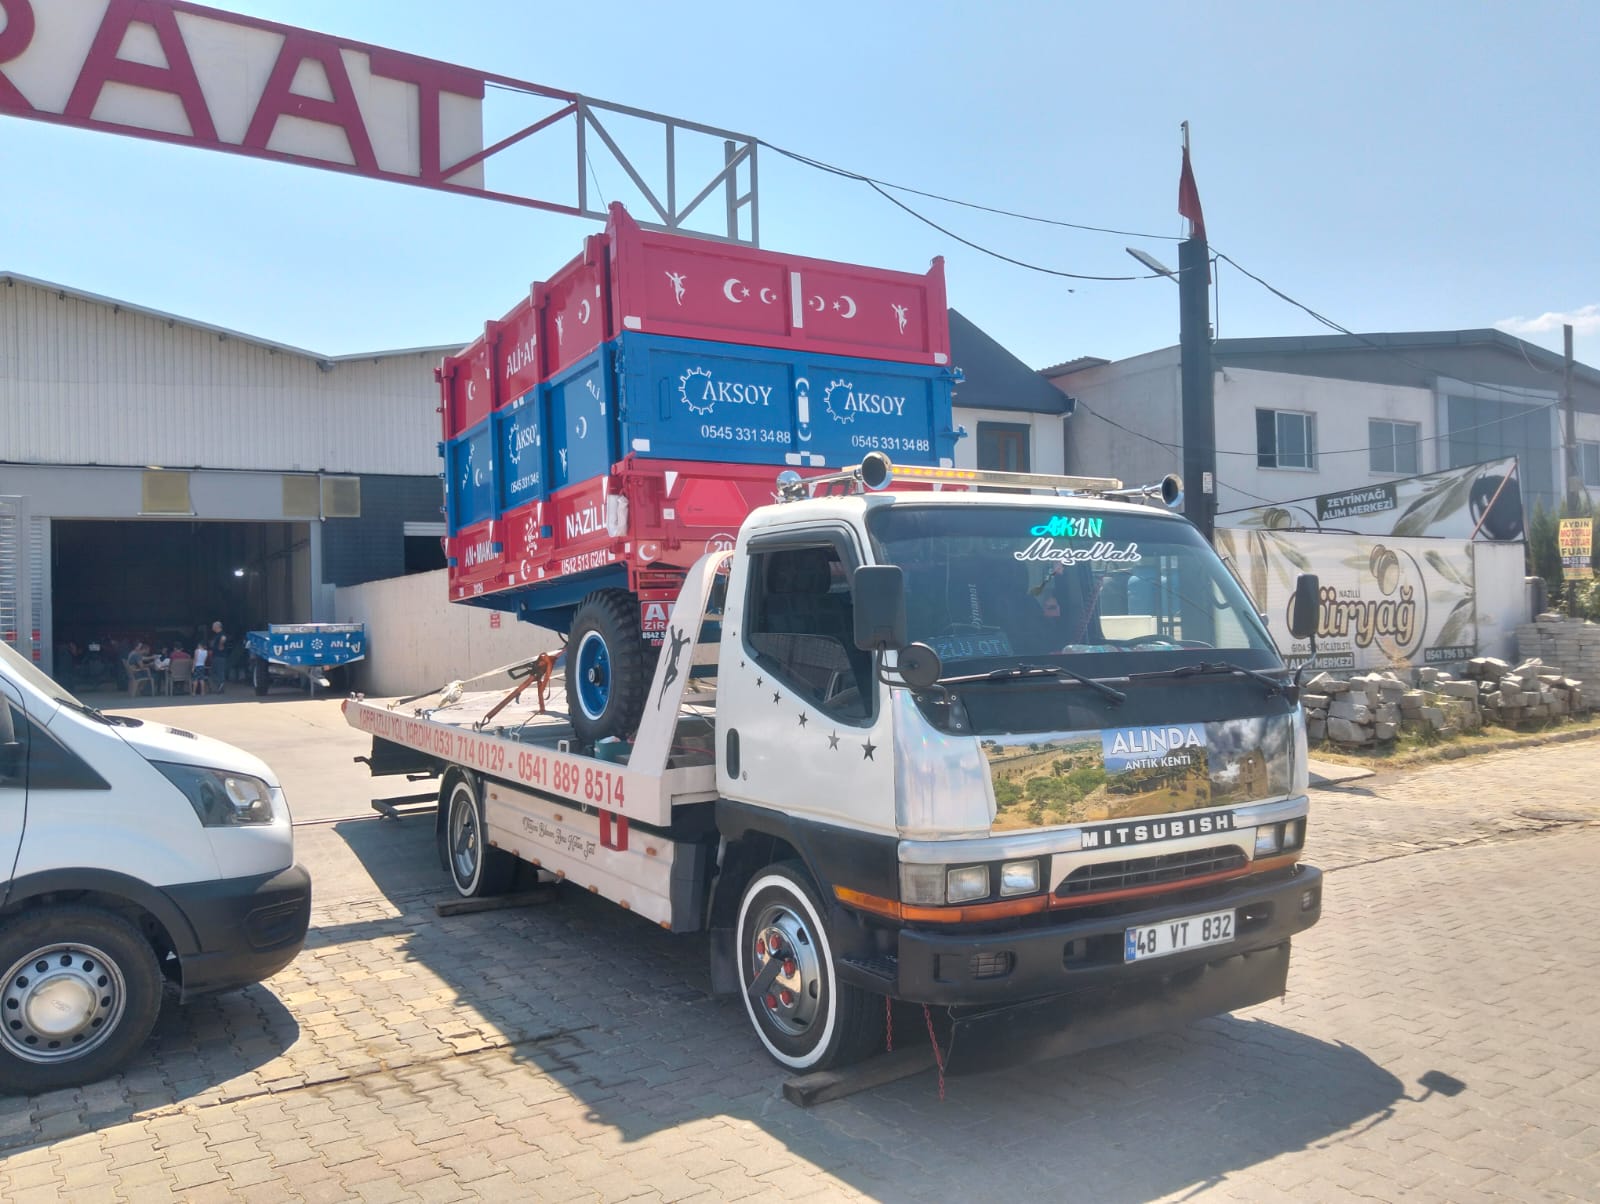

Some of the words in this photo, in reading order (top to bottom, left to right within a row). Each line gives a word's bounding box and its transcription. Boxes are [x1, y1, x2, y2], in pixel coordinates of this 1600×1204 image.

[702, 380, 773, 406] AKSOY
[844, 391, 905, 416] AKSOY
[701, 424, 733, 440] 0545
[736, 427, 757, 441] 331
[851, 434, 879, 449] 0545
[881, 437, 900, 450] 331
[1323, 508, 1346, 520] ALIM
[1348, 498, 1393, 517] MERKEZİ
[1327, 488, 1386, 508] ZEYTİNYAĞI
[1562, 520, 1590, 529] AYDIN
[1014, 537, 1142, 566] Maşallah
[1111, 727, 1201, 754] ALINDA
[391, 716, 405, 744] YOL
[434, 730, 453, 757] 0531
[457, 736, 475, 762] 714
[478, 741, 505, 773] 0129
[518, 751, 548, 786] 0541
[553, 759, 580, 795] 889
[584, 767, 626, 808] 8514
[1082, 812, 1239, 849] MITSUBISHI
[1136, 928, 1157, 955] 48
[1170, 921, 1189, 948] VT
[1202, 913, 1232, 942] 832
